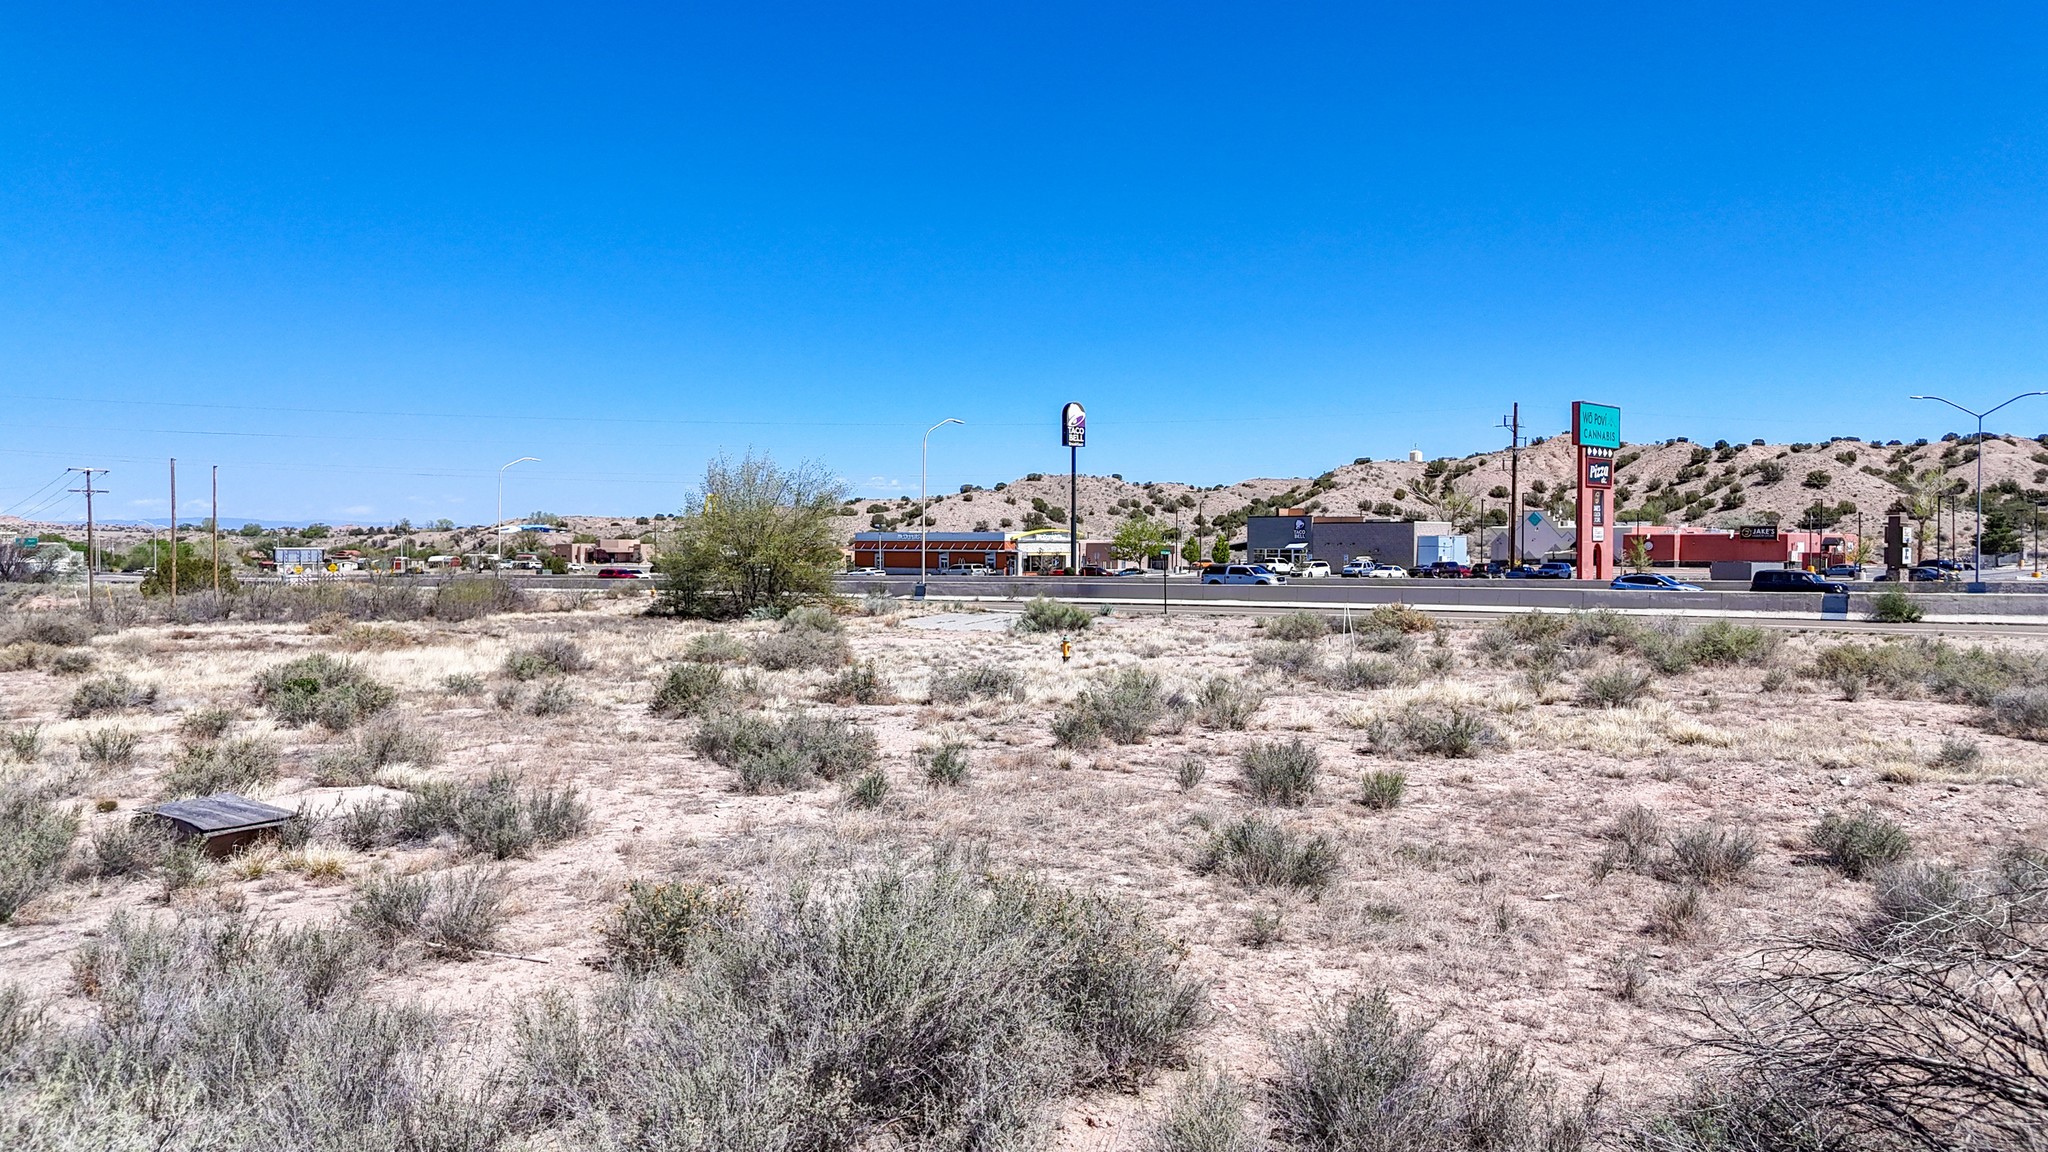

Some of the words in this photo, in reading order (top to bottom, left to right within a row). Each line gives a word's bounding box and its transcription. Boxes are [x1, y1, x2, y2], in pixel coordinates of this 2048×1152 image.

[1067, 426, 1084, 434] TACO
[1068, 434, 1084, 442] BELL
[1583, 428, 1615, 441] CANNABIS
